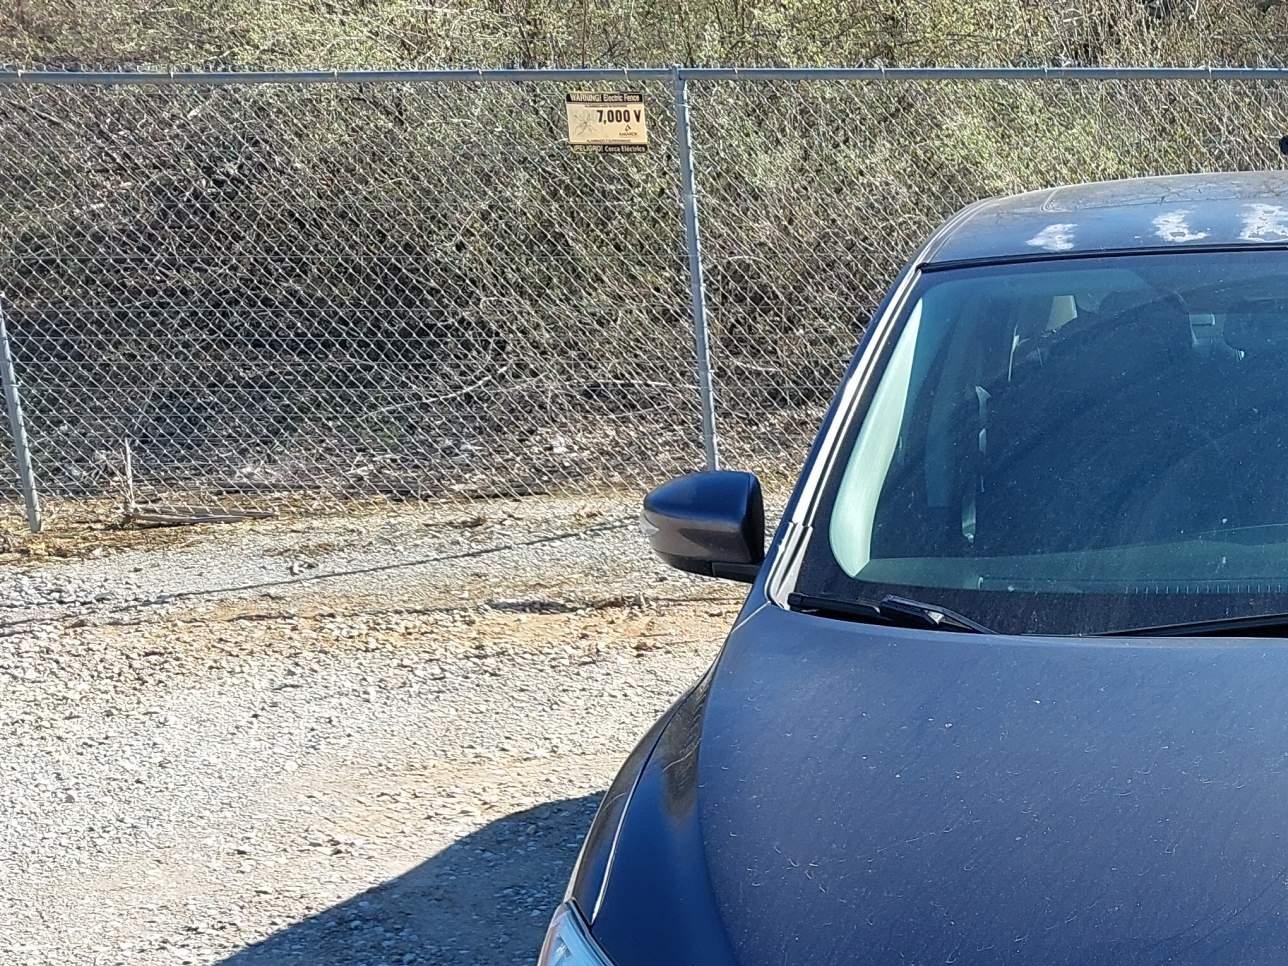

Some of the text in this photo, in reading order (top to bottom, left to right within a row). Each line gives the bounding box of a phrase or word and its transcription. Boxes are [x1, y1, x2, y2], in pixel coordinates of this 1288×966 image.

[603, 94, 623, 102] Electric
[624, 94, 640, 102] Fence
[597, 110, 641, 125] 7,000 V
